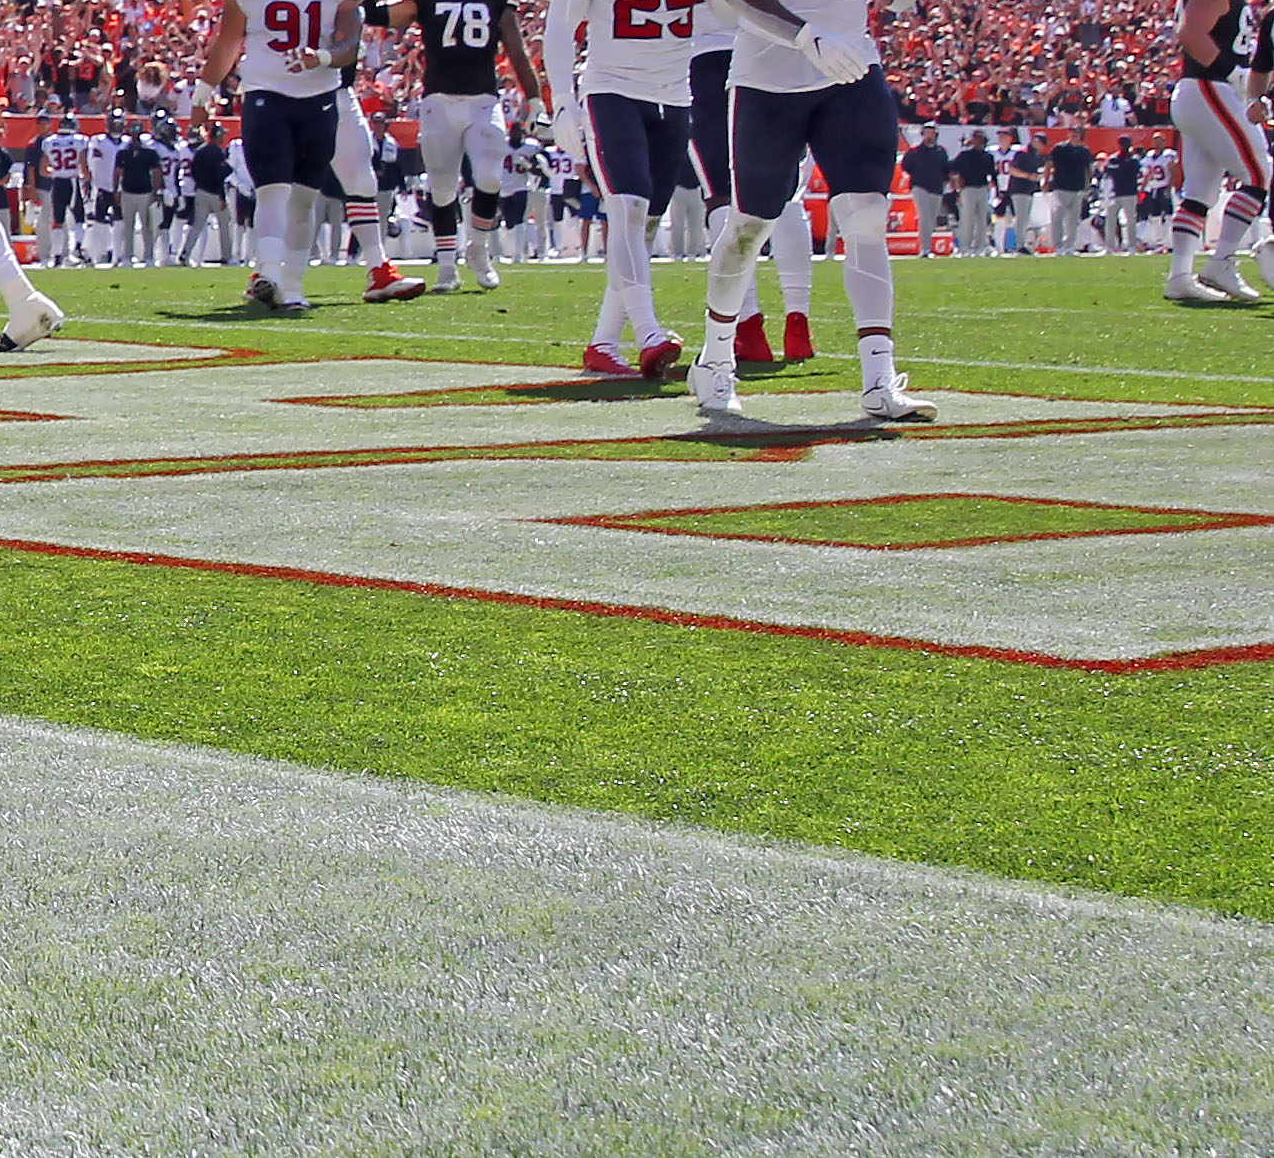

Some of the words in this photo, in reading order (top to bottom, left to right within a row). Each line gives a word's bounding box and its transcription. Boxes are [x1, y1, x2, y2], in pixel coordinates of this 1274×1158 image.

[265, 1, 320, 52] 91
[435, 2, 491, 48] 78
[51, 148, 78, 171] 32
[549, 158, 572, 174] 93
